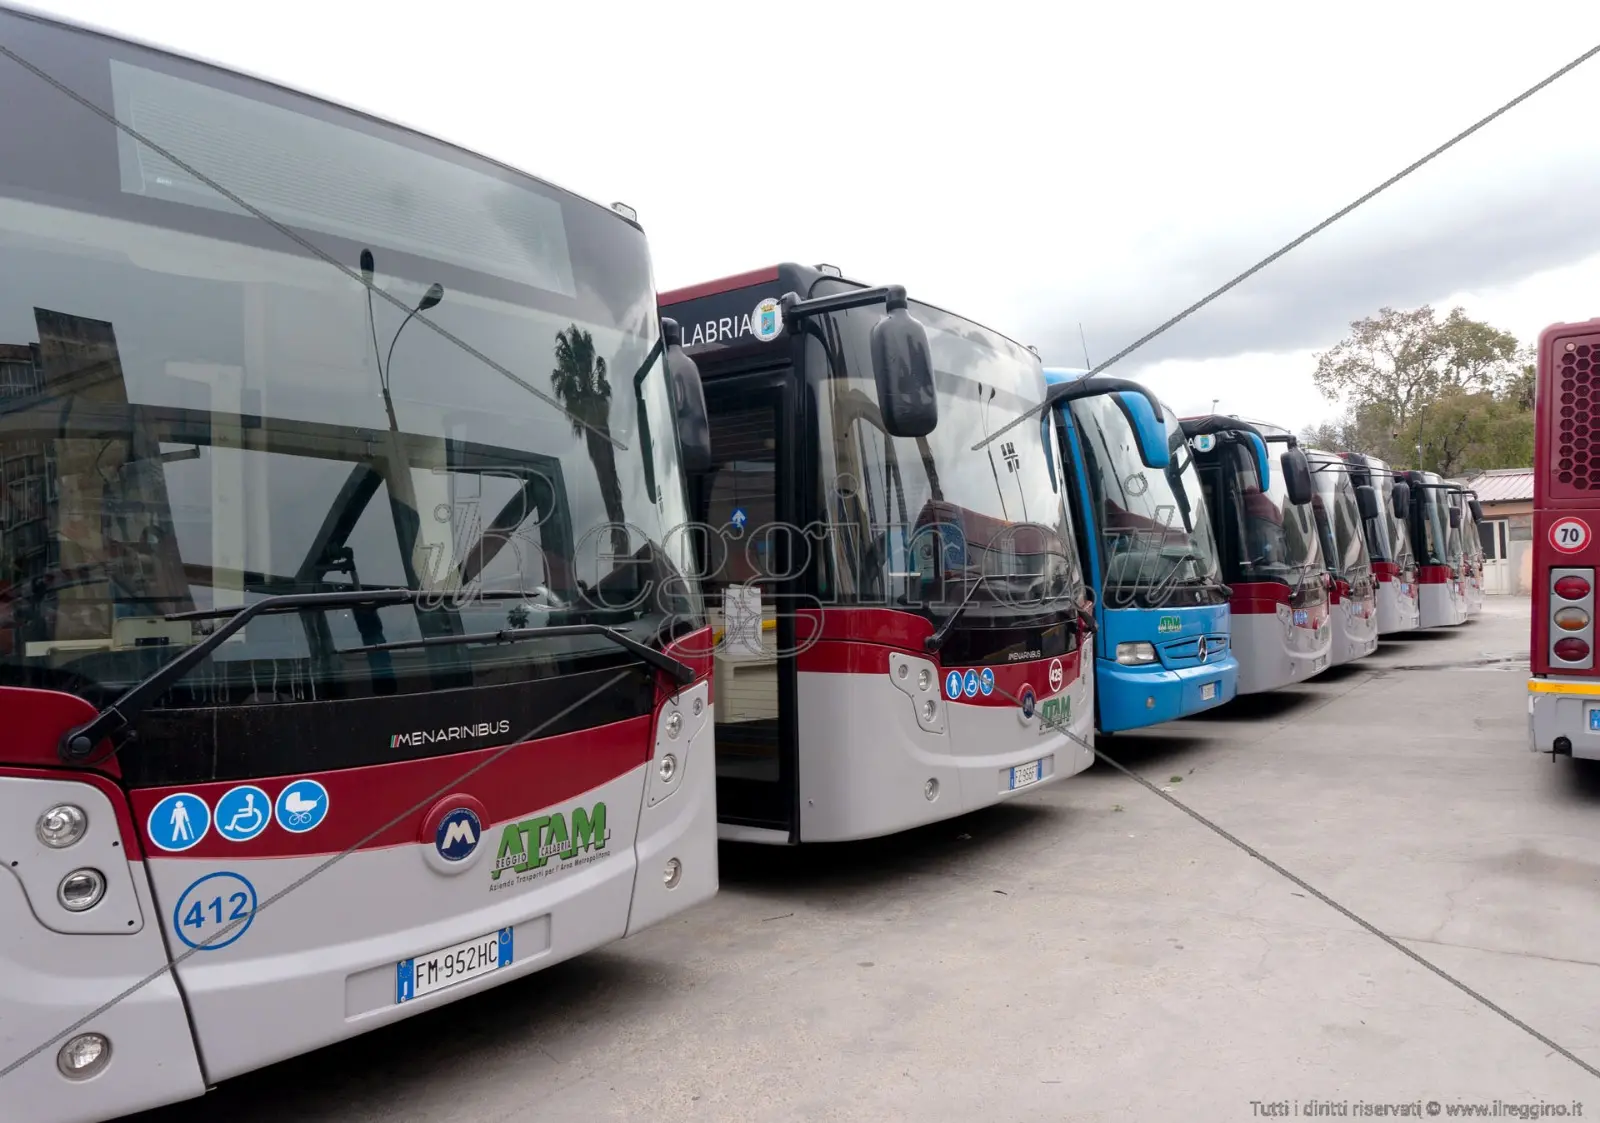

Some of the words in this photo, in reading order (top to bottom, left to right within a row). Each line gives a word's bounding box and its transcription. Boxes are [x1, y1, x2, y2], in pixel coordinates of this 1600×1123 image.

[1560, 528, 1579, 542] 70
[397, 719, 510, 747] MENARINIBUS
[441, 819, 476, 850] M
[490, 801, 606, 880] ATAM
[495, 853, 527, 869] REGGIO
[541, 841, 571, 856] CALABRIA
[489, 880, 514, 892] Azienda
[516, 870, 544, 883] Trasporti
[544, 867, 555, 877] per
[560, 862, 573, 871] Area
[574, 850, 611, 866] Metropolitana
[183, 891, 248, 928] 412
